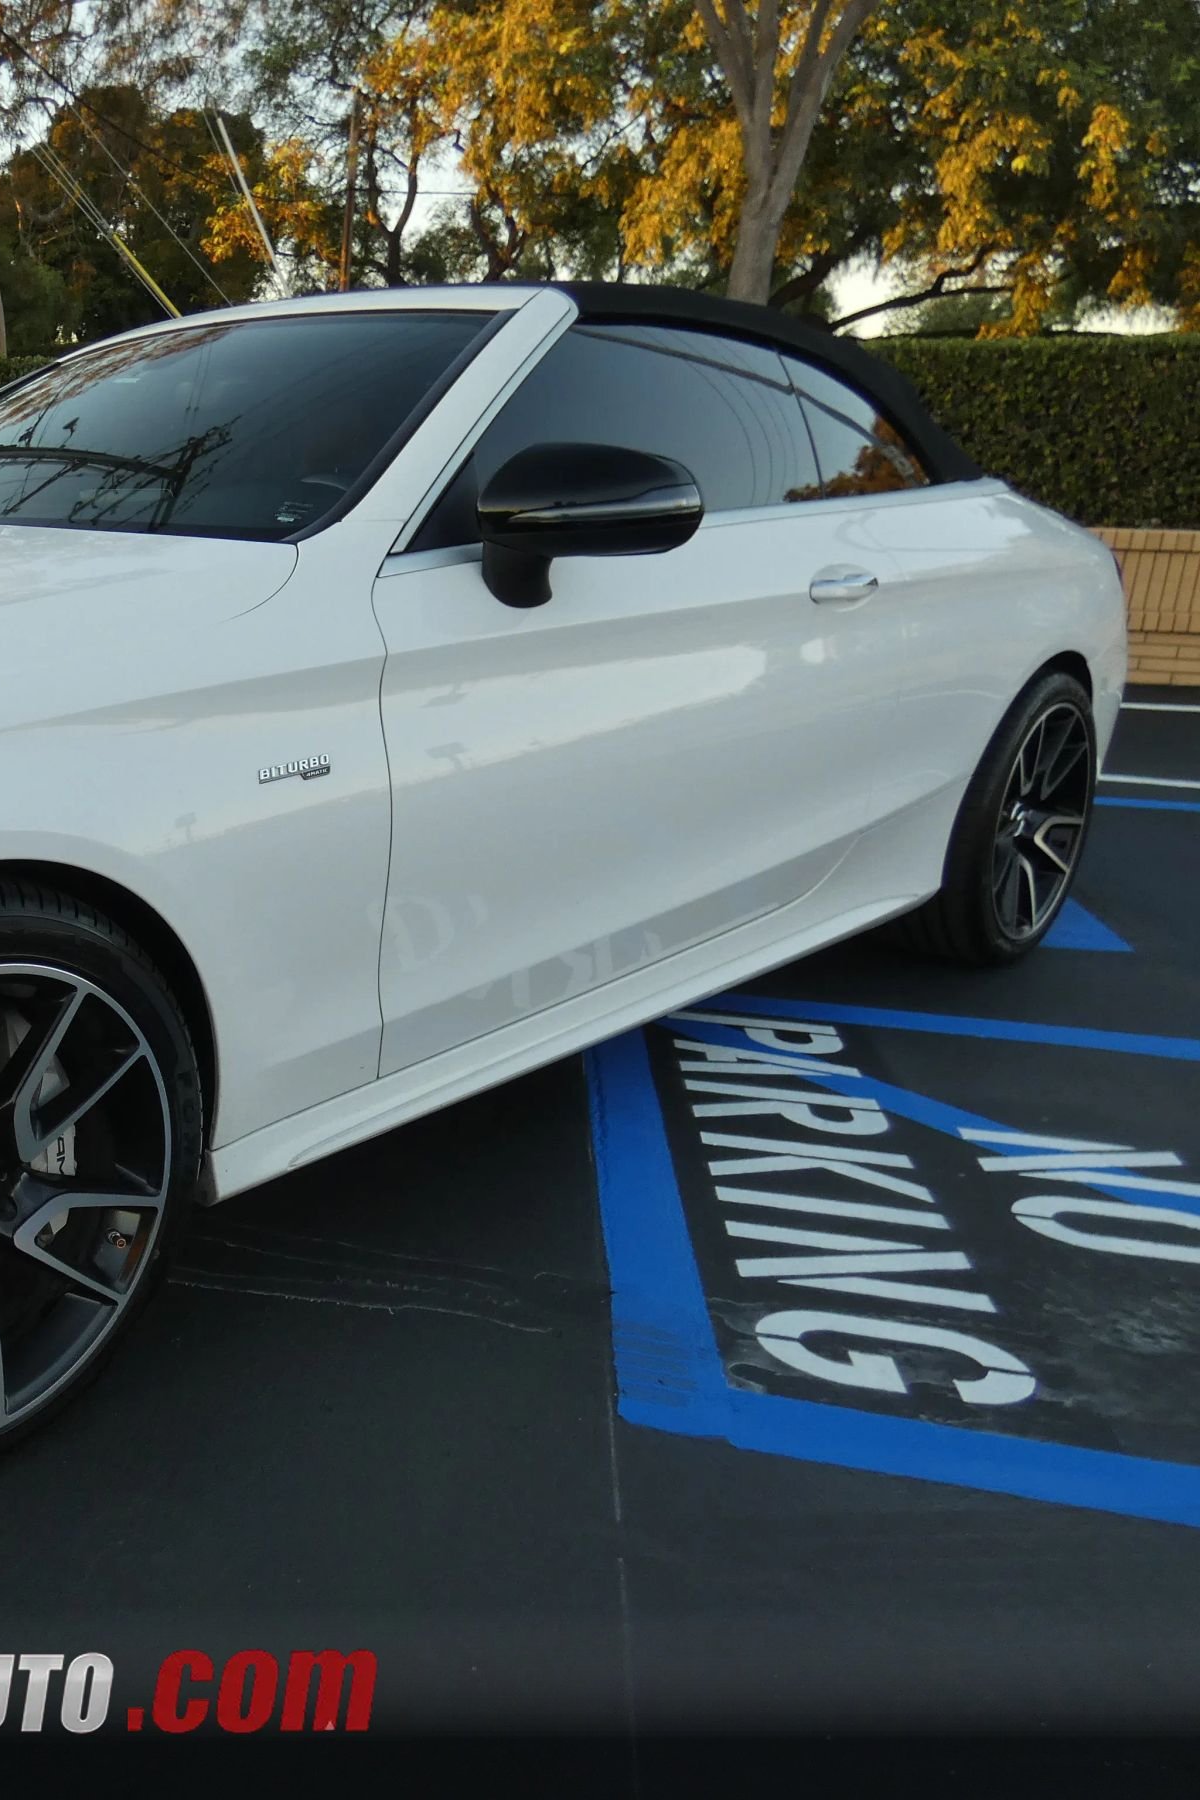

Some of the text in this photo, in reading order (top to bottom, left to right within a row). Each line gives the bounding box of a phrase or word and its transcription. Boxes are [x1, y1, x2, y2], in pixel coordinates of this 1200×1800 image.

[258, 754, 329, 781] BITURBO
[666, 1011, 1037, 1405] PARKING
[958, 1127, 1200, 1264] NO
